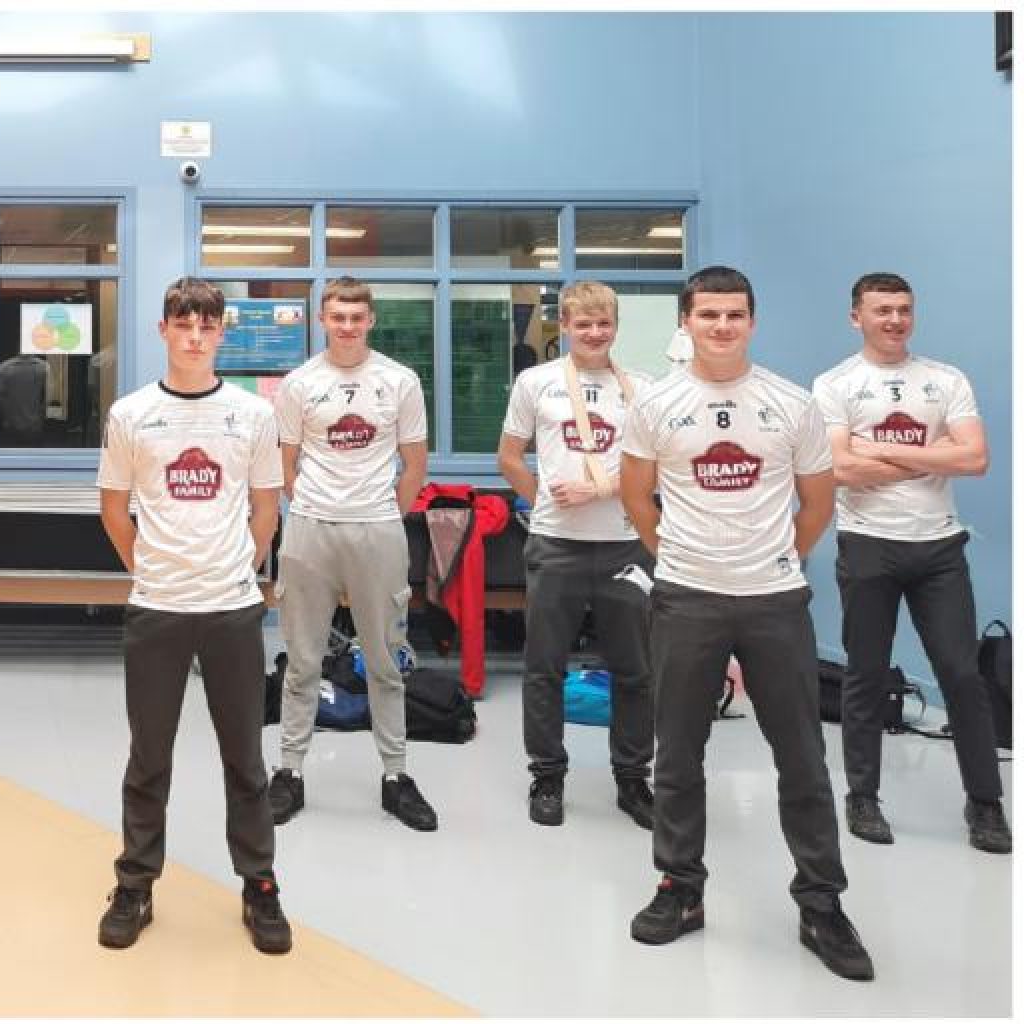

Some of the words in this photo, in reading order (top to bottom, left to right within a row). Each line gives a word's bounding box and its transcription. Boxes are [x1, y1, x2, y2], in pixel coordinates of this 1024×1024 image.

[345, 389, 355, 404] 7
[585, 389, 598, 404] 11
[890, 387, 902, 402] 3
[716, 410, 731, 429] 8
[877, 428, 923, 443] BRADY
[169, 466, 218, 484] BRADY
[697, 461, 757, 477] BRADY
